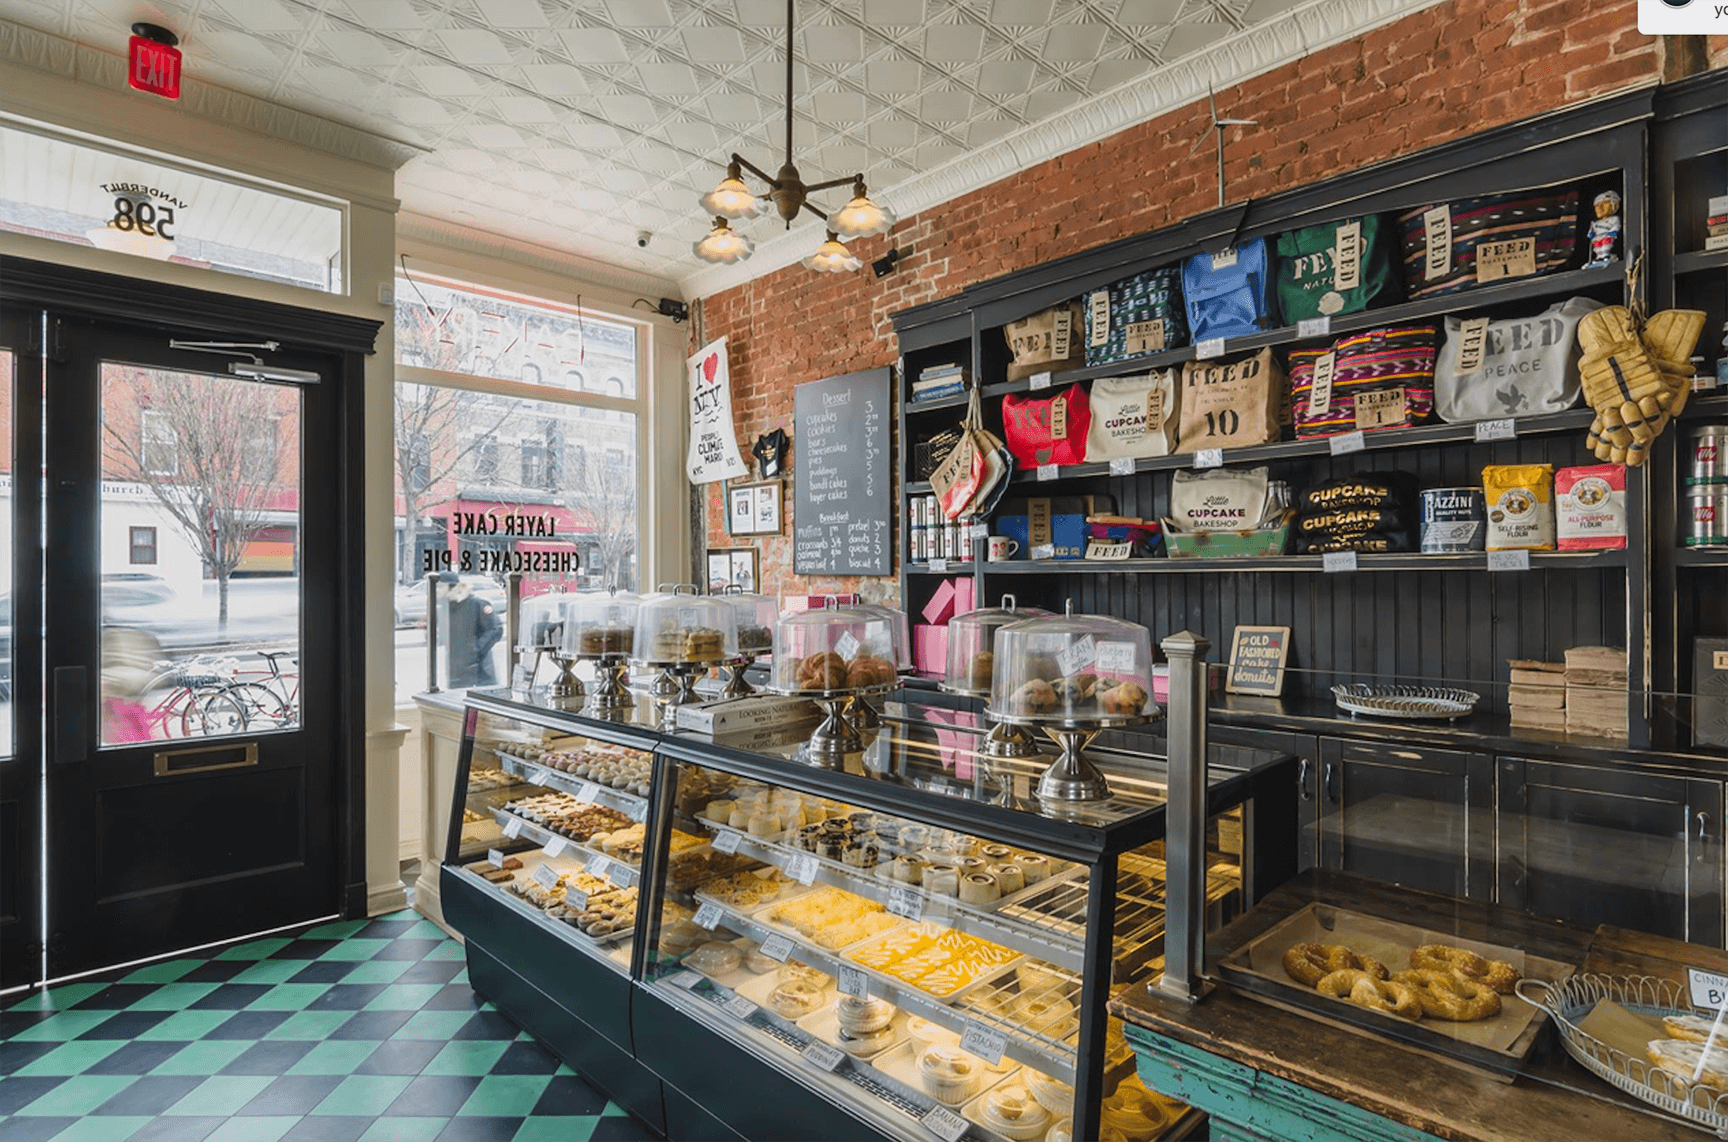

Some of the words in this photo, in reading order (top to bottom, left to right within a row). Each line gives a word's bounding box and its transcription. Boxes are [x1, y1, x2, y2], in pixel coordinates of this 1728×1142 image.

[136, 44, 178, 92] EXIT
[1431, 217, 1446, 269] FEED
[1482, 240, 1530, 258] FEED
[1293, 247, 1336, 280] FE
[1340, 234, 1355, 282] FEED
[1502, 264, 1509, 275] 1
[1303, 276, 1335, 290] NATU
[1095, 300, 1107, 340] FEED
[1129, 322, 1160, 334] FEED
[1055, 319, 1068, 354] FEED
[1485, 318, 1564, 357] EED
[1461, 326, 1483, 369] FEED
[1188, 360, 1260, 387] FEED
[1485, 359, 1542, 379] PEACE
[696, 362, 703, 391] I
[1315, 362, 1330, 408] FEED
[822, 388, 851, 406] Dessert
[1358, 391, 1400, 405] FEED
[865, 400, 873, 413] 3
[1054, 403, 1064, 437] FEED
[1105, 415, 1147, 429] CUPCAK
[1204, 409, 1239, 437] 10
[1377, 411, 1382, 423] 1
[807, 424, 836, 438] cookies
[1112, 427, 1147, 438] BAKESHO
[866, 438, 873, 448] 6
[866, 460, 873, 471] 5
[867, 473, 873, 485] 5
[103, 484, 143, 494] hurch
[866, 485, 874, 497] 6
[1308, 485, 1389, 503] CUPCAKE
[1187, 508, 1246, 518] CUPCAKE
[1302, 510, 1382, 530] CUPCAKE
[1193, 519, 1239, 528] BAKESHOP
[1579, 521, 1603, 529] FLOUR
[874, 533, 881, 544] 2
[874, 544, 882, 555] 3
[1093, 546, 1128, 557] FEED
[874, 557, 881, 569] 4
[1250, 635, 1269, 646] OLD
[1234, 666, 1276, 685] donuts
[965, 1028, 1001, 1053] PISTACHIO
[932, 1106, 964, 1131] BANANA
